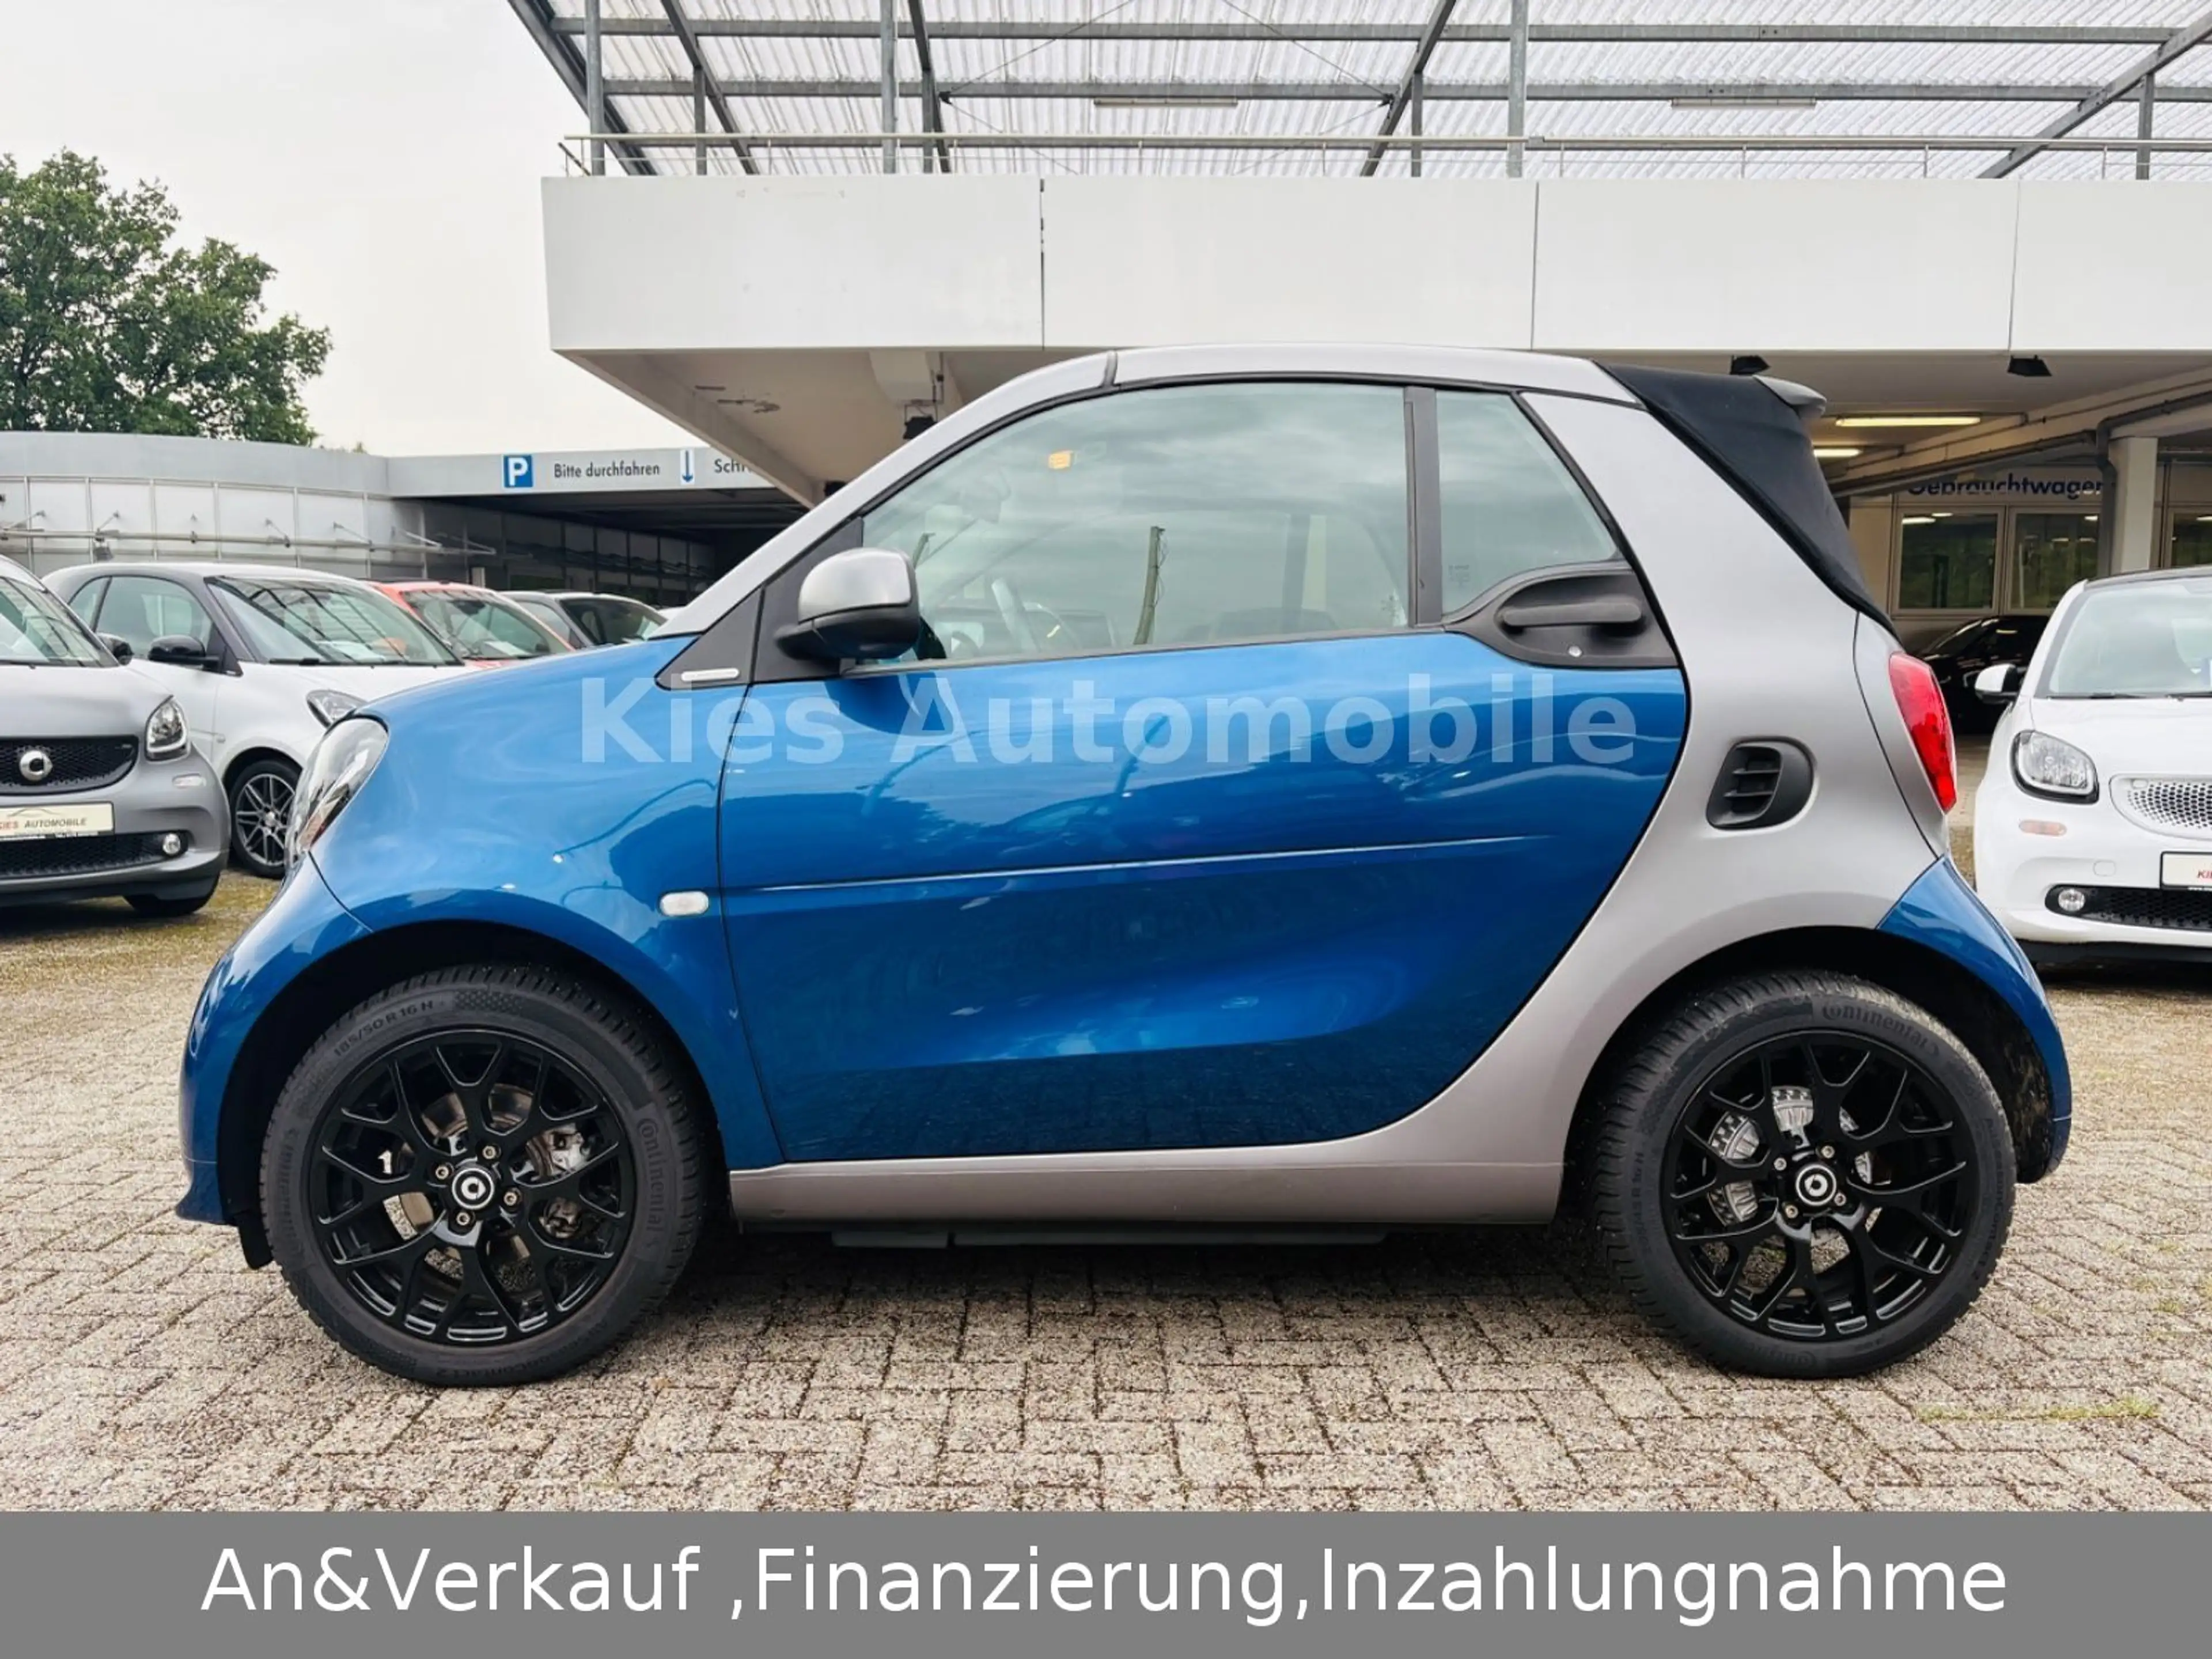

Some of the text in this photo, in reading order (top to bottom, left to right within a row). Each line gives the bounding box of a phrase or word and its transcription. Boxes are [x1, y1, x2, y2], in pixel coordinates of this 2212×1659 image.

[508, 457, 528, 486] P
[554, 460, 661, 478] Bitte durchfahren
[25, 817, 87, 828] AUTOMOBILE
[1823, 1005, 1928, 1050] Continental
[637, 1118, 665, 1232] Continental
